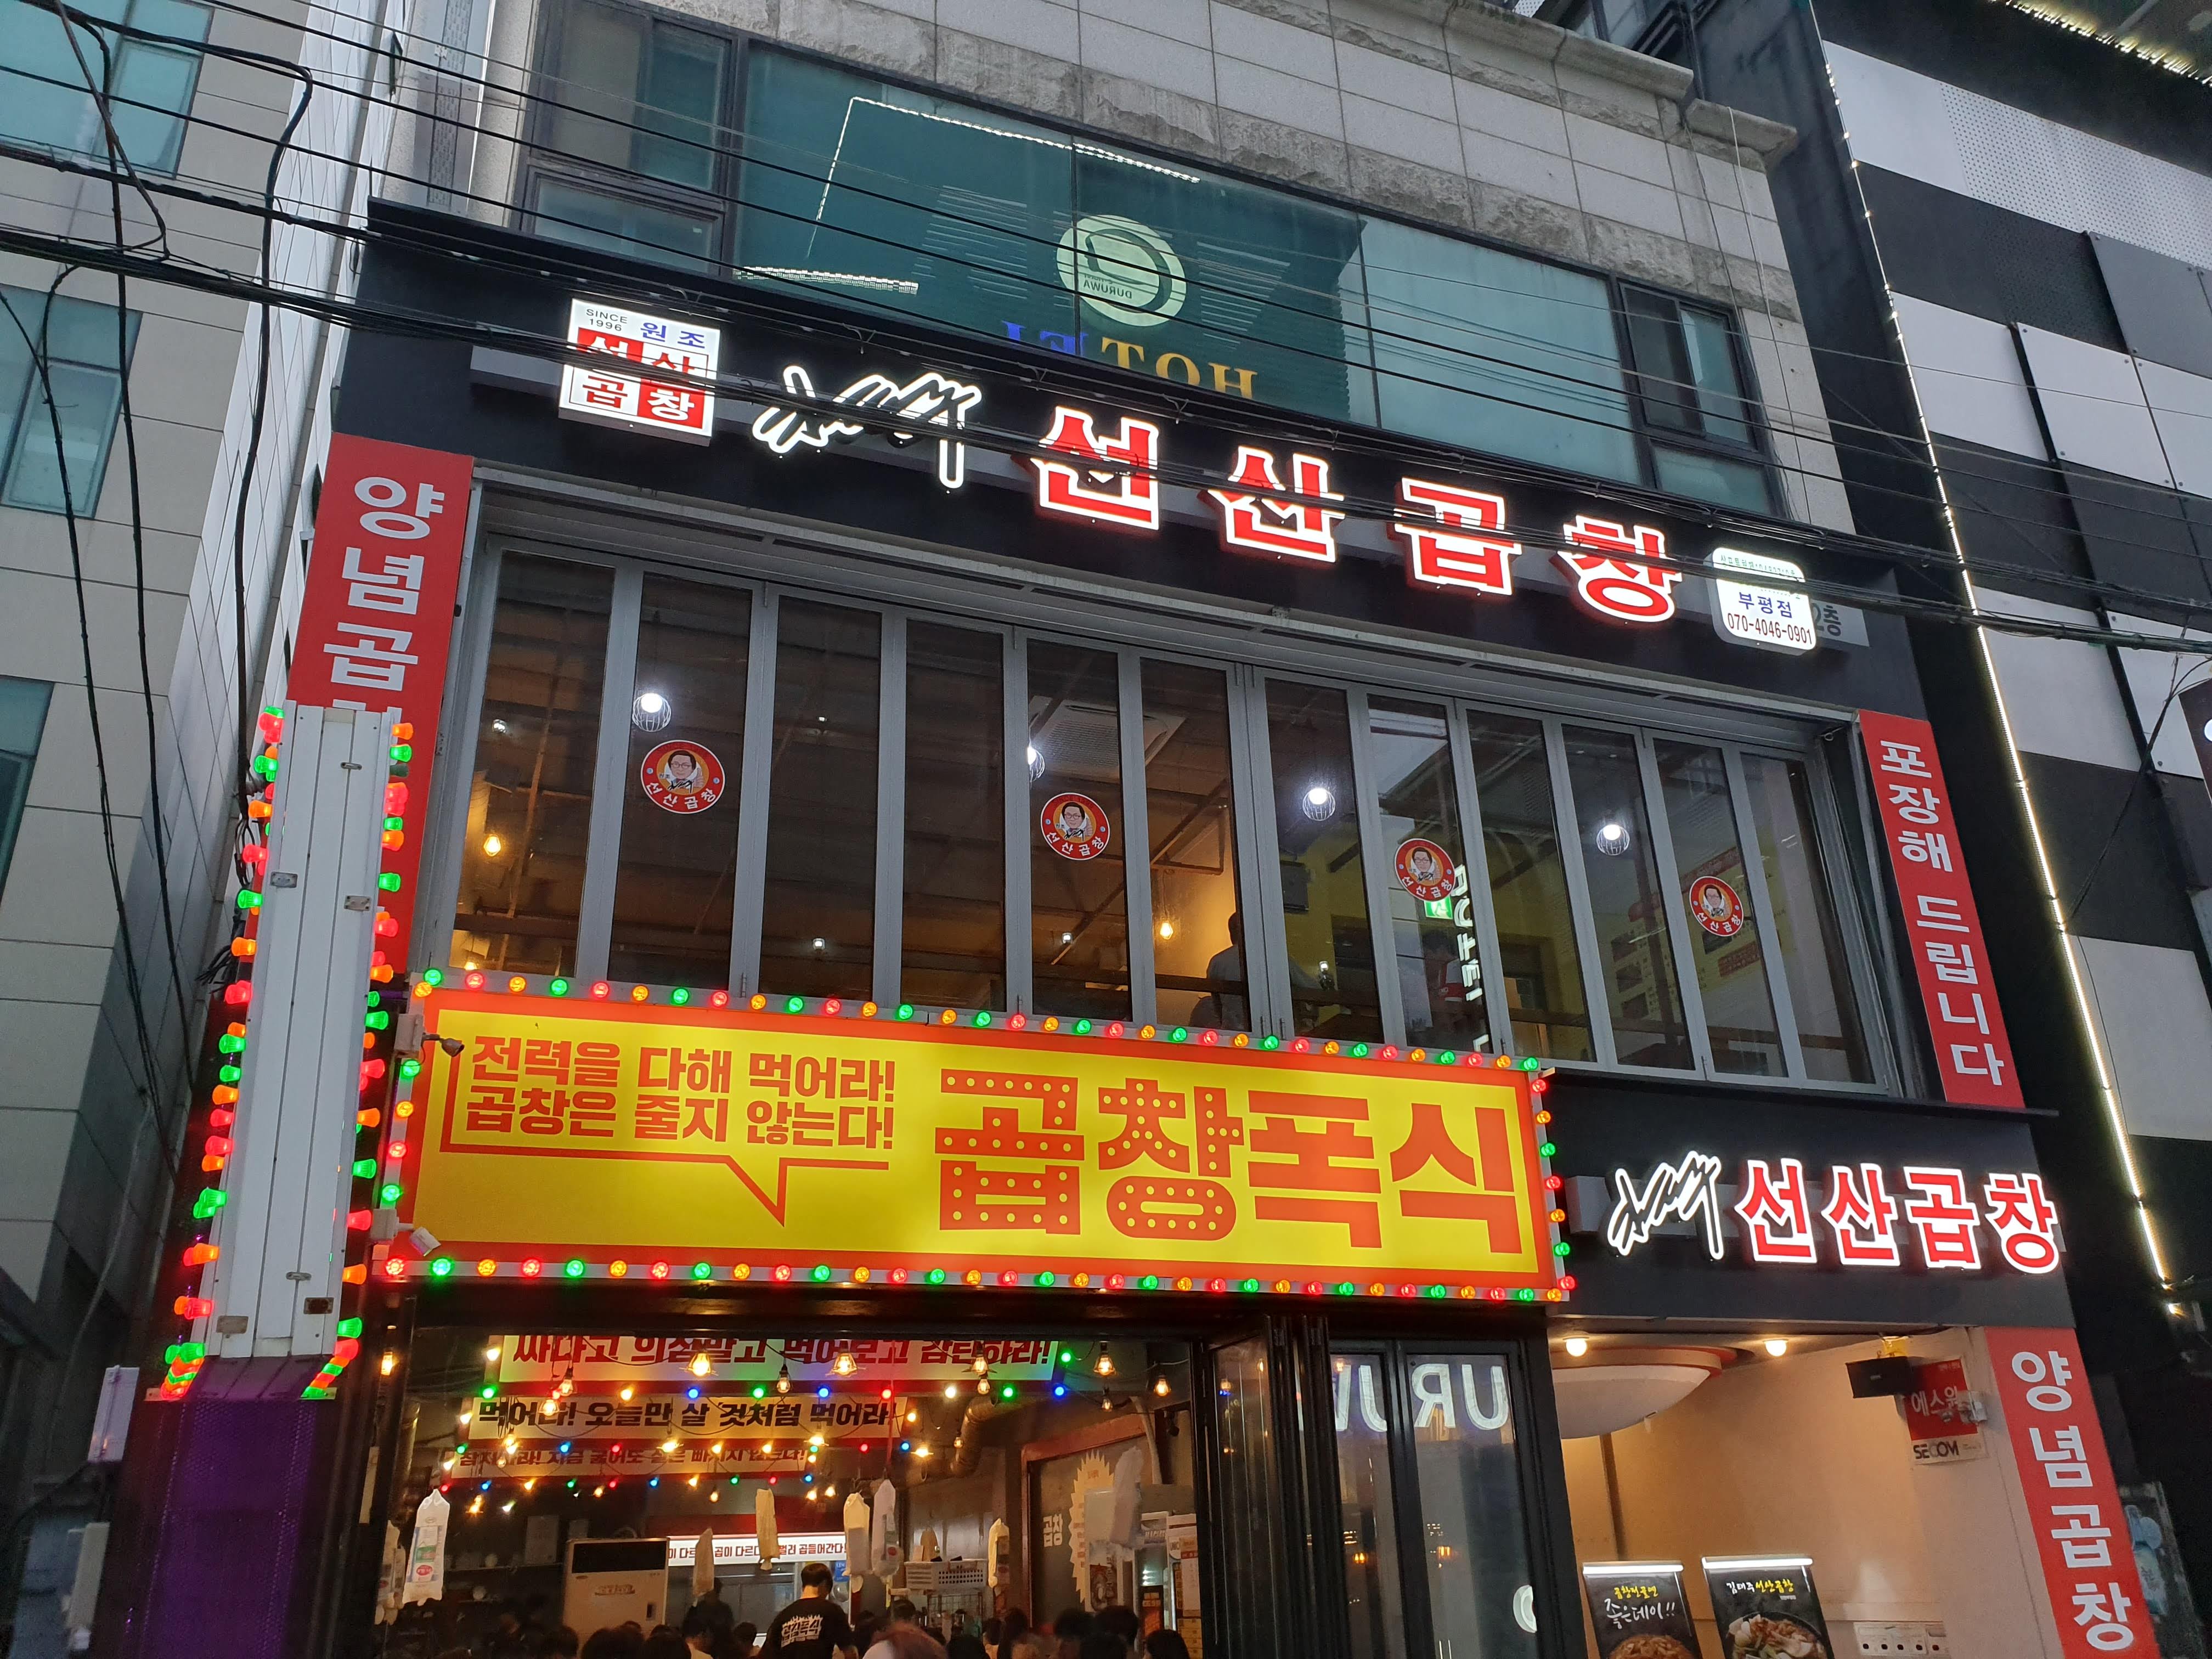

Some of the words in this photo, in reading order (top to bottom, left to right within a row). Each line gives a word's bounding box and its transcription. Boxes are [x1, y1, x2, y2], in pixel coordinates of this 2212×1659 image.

[586, 308, 628, 324] SINCE
[589, 319, 622, 331] 1996
[640, 322, 706, 348] 원조
[582, 375, 695, 421] 곱창
[1031, 405, 1683, 623] 선산곱창
[323, 476, 445, 714] 양념곱
[1738, 591, 1793, 619] 부평점
[1727, 612, 1813, 645] 070-4046-0901
[646, 782, 716, 810] 선산곱창
[1880, 740, 1953, 872] 포장해
[1046, 832, 1105, 856] 선산곱창
[1401, 875, 1453, 898] 선산곱창
[1696, 912, 1742, 933] 선산곱창
[1916, 895, 2004, 1086] 드립니다
[471, 1035, 620, 1088] 전력을
[637, 1047, 732, 1094] 다해
[748, 1052, 896, 1102] 먹어라!
[466, 1085, 617, 1138] 곱창은
[634, 1094, 728, 1143] 줄지
[746, 1099, 894, 1150] 않는다!
[935, 1068, 1522, 1254] 곱창폭식
[1734, 1157, 2061, 1274] 선산곱창
[513, 1335, 619, 1363] 싸다고
[630, 1337, 769, 1364] 의심말고
[784, 1339, 910, 1364] 먹어보고
[479, 1401, 577, 1426] 먹어라!
[585, 1402, 674, 1426] 오늘만
[681, 1402, 710, 1427] 살
[1911, 1385, 1959, 1416] 에스원
[1913, 1440, 1960, 1460] SECOM
[2011, 1350, 2134, 1651] 양념곱창
[1043, 1513, 1063, 1548] 곱창
[714, 1546, 732, 1558] 곱이
[1604, 1598, 1675, 1630] 좋은데이!!
